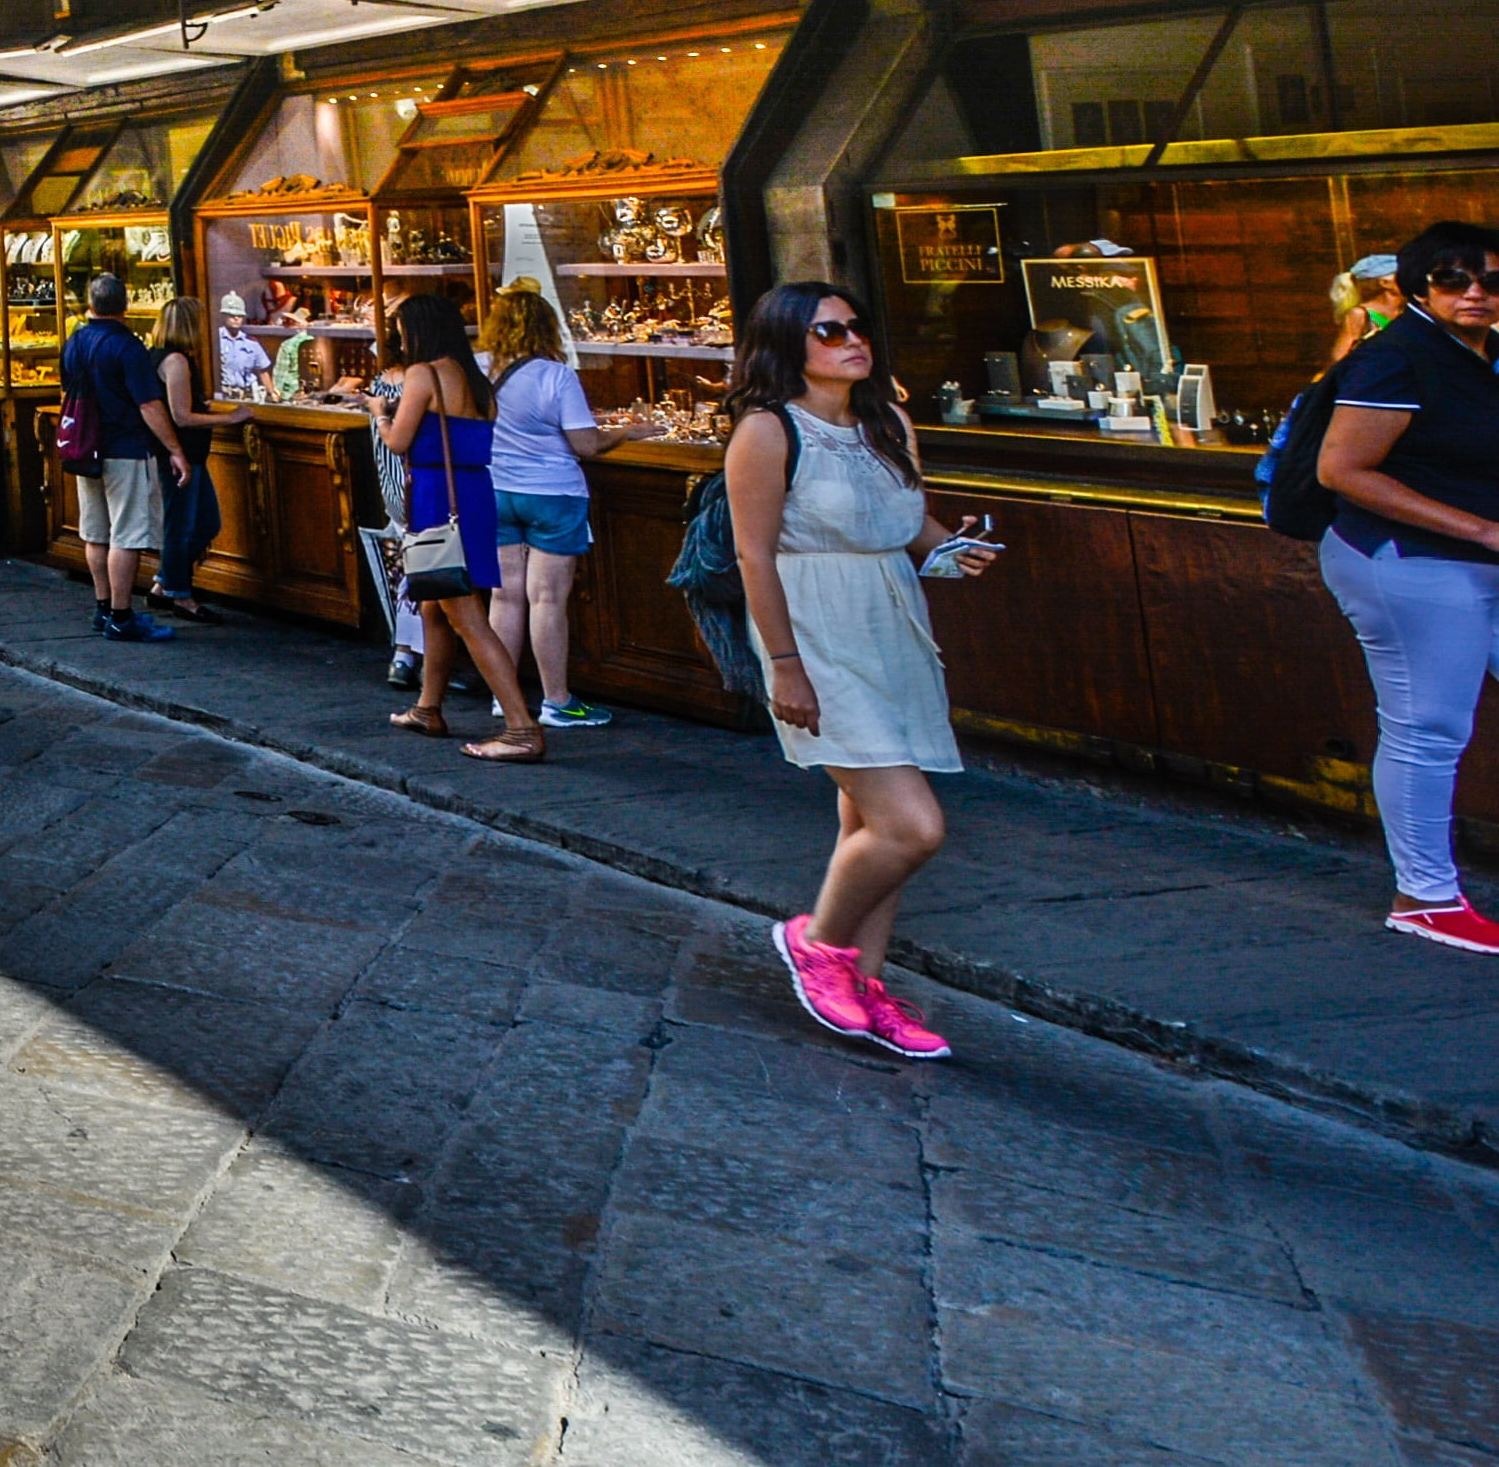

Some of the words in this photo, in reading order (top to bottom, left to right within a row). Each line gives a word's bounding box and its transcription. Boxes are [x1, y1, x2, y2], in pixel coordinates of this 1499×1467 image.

[918, 245, 982, 257] FRATELLI
[920, 257, 984, 271] PICCINI
[1051, 275, 1123, 289] MESSIKA
